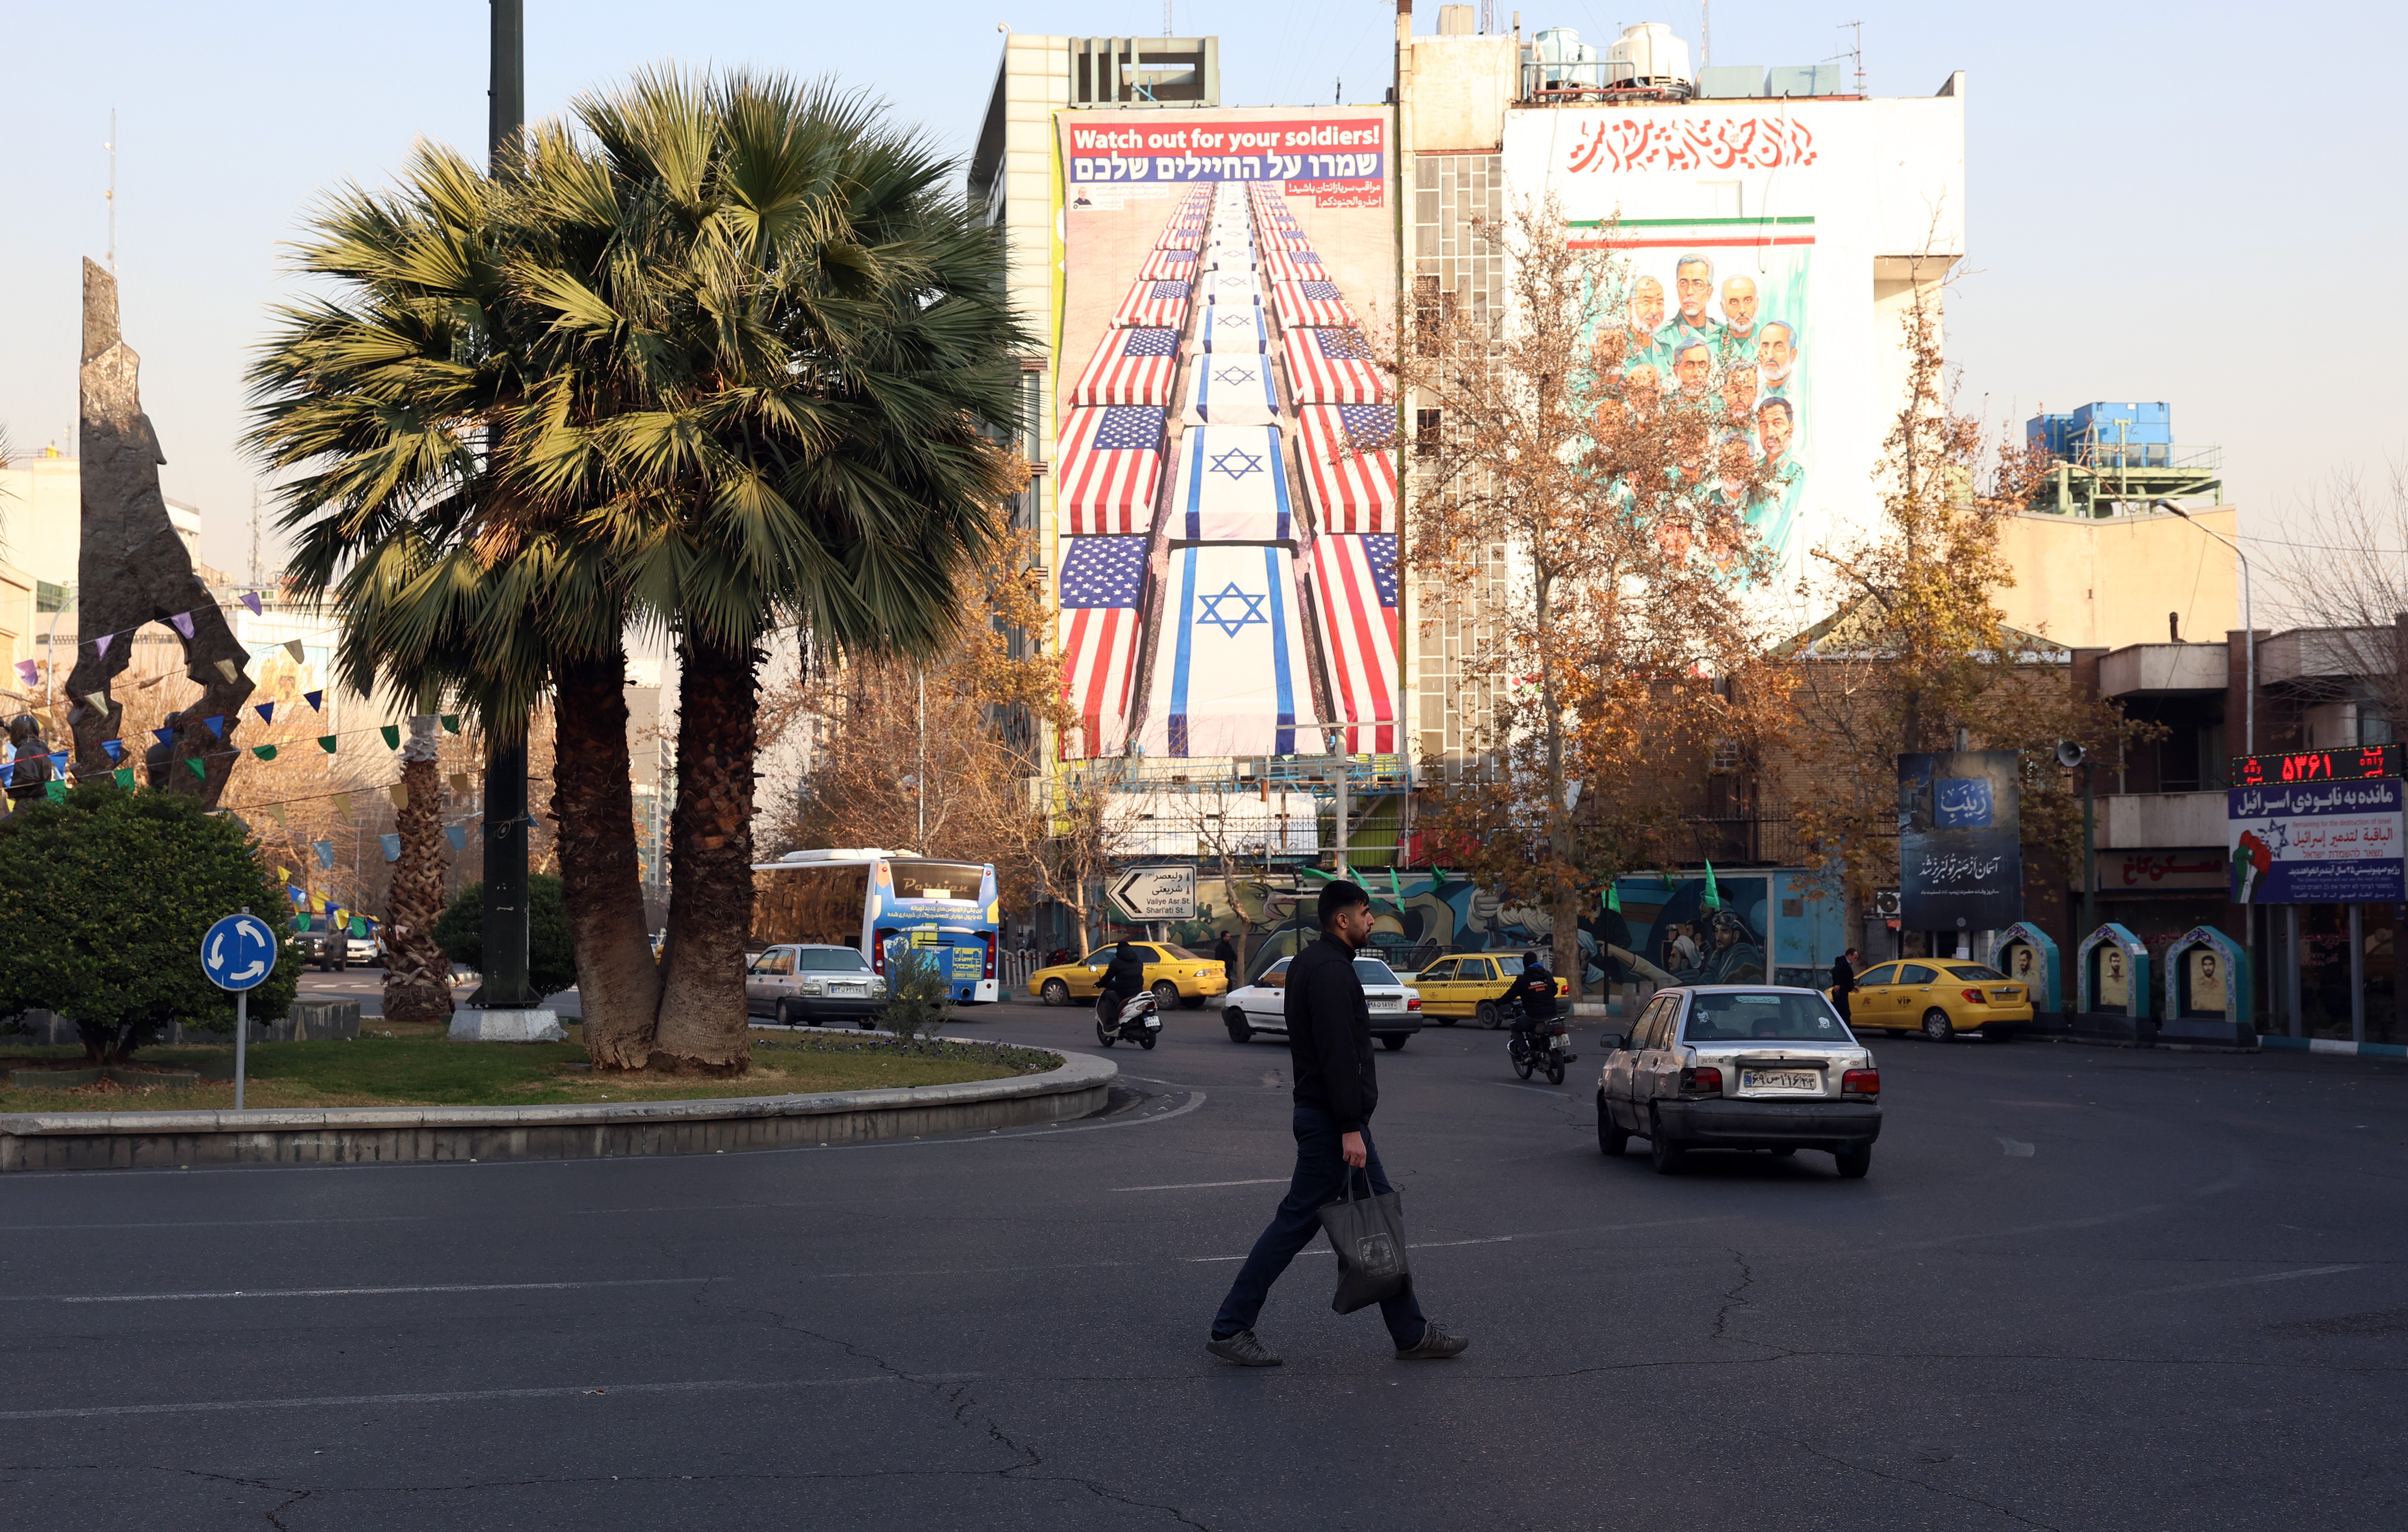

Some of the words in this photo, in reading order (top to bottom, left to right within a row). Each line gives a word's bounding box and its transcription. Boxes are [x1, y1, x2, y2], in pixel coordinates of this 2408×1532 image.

[1074, 129, 1142, 149] Watch
[1148, 131, 1187, 149] out
[1191, 128, 1224, 148] for
[1228, 132, 1281, 153] your
[1285, 125, 1380, 146] soldiers!
[1074, 150, 1149, 180] שלכם
[1156, 150, 1260, 179] החיילים
[1267, 148, 1302, 179] על
[1308, 154, 1377, 177] שמרו
[1288, 182, 1315, 194] باشید!
[1316, 181, 1354, 194] سربازانتان
[1355, 181, 1381, 191] مراقب
[2244, 764, 2261, 775] day
[2282, 754, 2332, 781] ۵۳۶۱
[2359, 756, 2384, 769] only
[2237, 789, 2290, 816] اسرائیل
[2291, 786, 2342, 813] نابودی
[2343, 790, 2357, 809] به
[2358, 784, 2394, 805] مانده
[2330, 829, 2358, 847] لتدمير
[2364, 827, 2393, 846] الباقية
[903, 878, 970, 892] Parsian
[1153, 872, 1183, 882] ولیعصر
[1152, 884, 1183, 895] شریعتی
